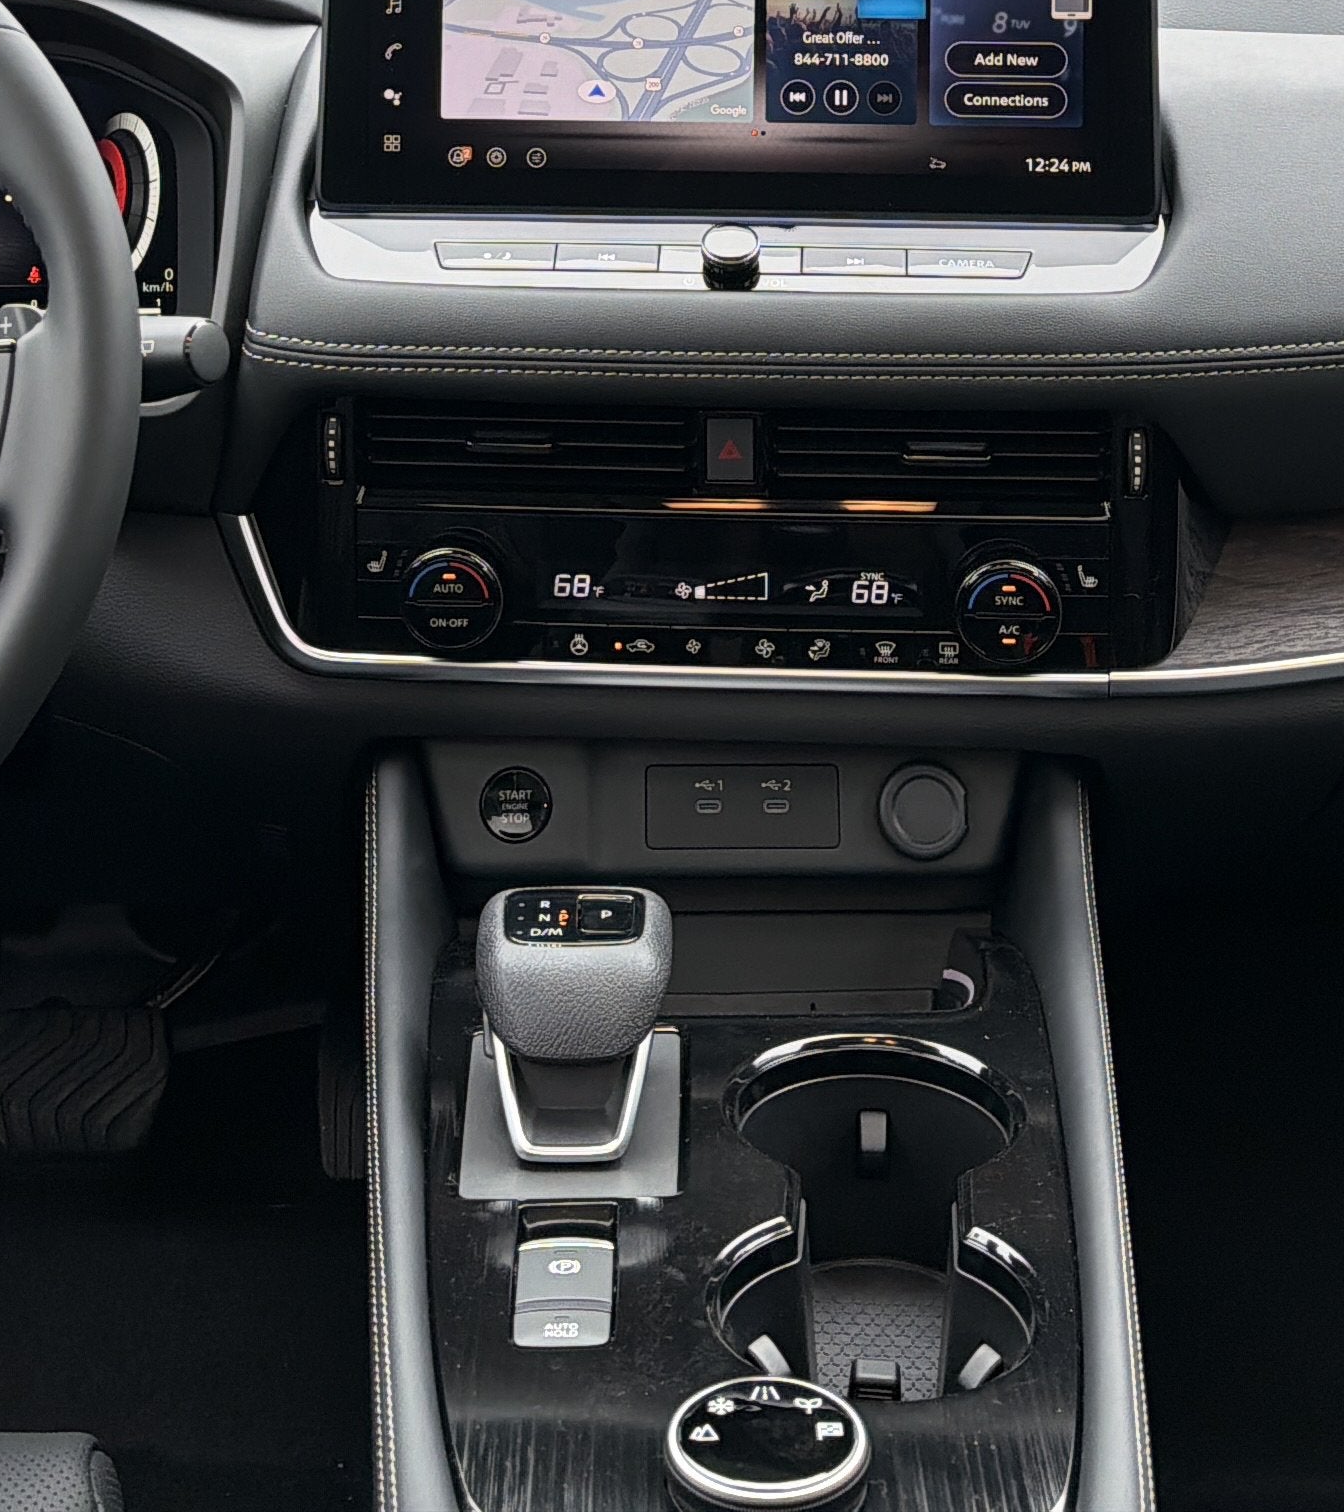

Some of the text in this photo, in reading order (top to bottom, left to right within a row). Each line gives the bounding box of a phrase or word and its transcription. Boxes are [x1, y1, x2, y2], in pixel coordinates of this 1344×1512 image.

[992, 11, 1008, 34] 8
[803, 32, 865, 45] Great Offer
[794, 53, 888, 67] 844-711-8800
[975, 53, 1038, 66] Add New
[964, 94, 1049, 107] Connections
[711, 104, 746, 117] Google
[1026, 158, 1091, 172] 12:24 PM
[939, 259, 994, 268] CAMERA
[165, 268, 173, 280] 0
[142, 282, 173, 293] km/h
[860, 572, 885, 581] SYNC
[433, 584, 463, 593] AUTO
[995, 596, 1024, 606] SYNC
[999, 625, 1021, 635] A/C
[874, 656, 899, 664] FRONT
[717, 780, 724, 791] 1
[783, 780, 791, 791] 2
[498, 790, 532, 800] START
[501, 803, 528, 811] ENGINE
[501, 813, 530, 824] STOP
[540, 900, 551, 908] R
[600, 910, 612, 919] P
[530, 928, 563, 936] D/M
